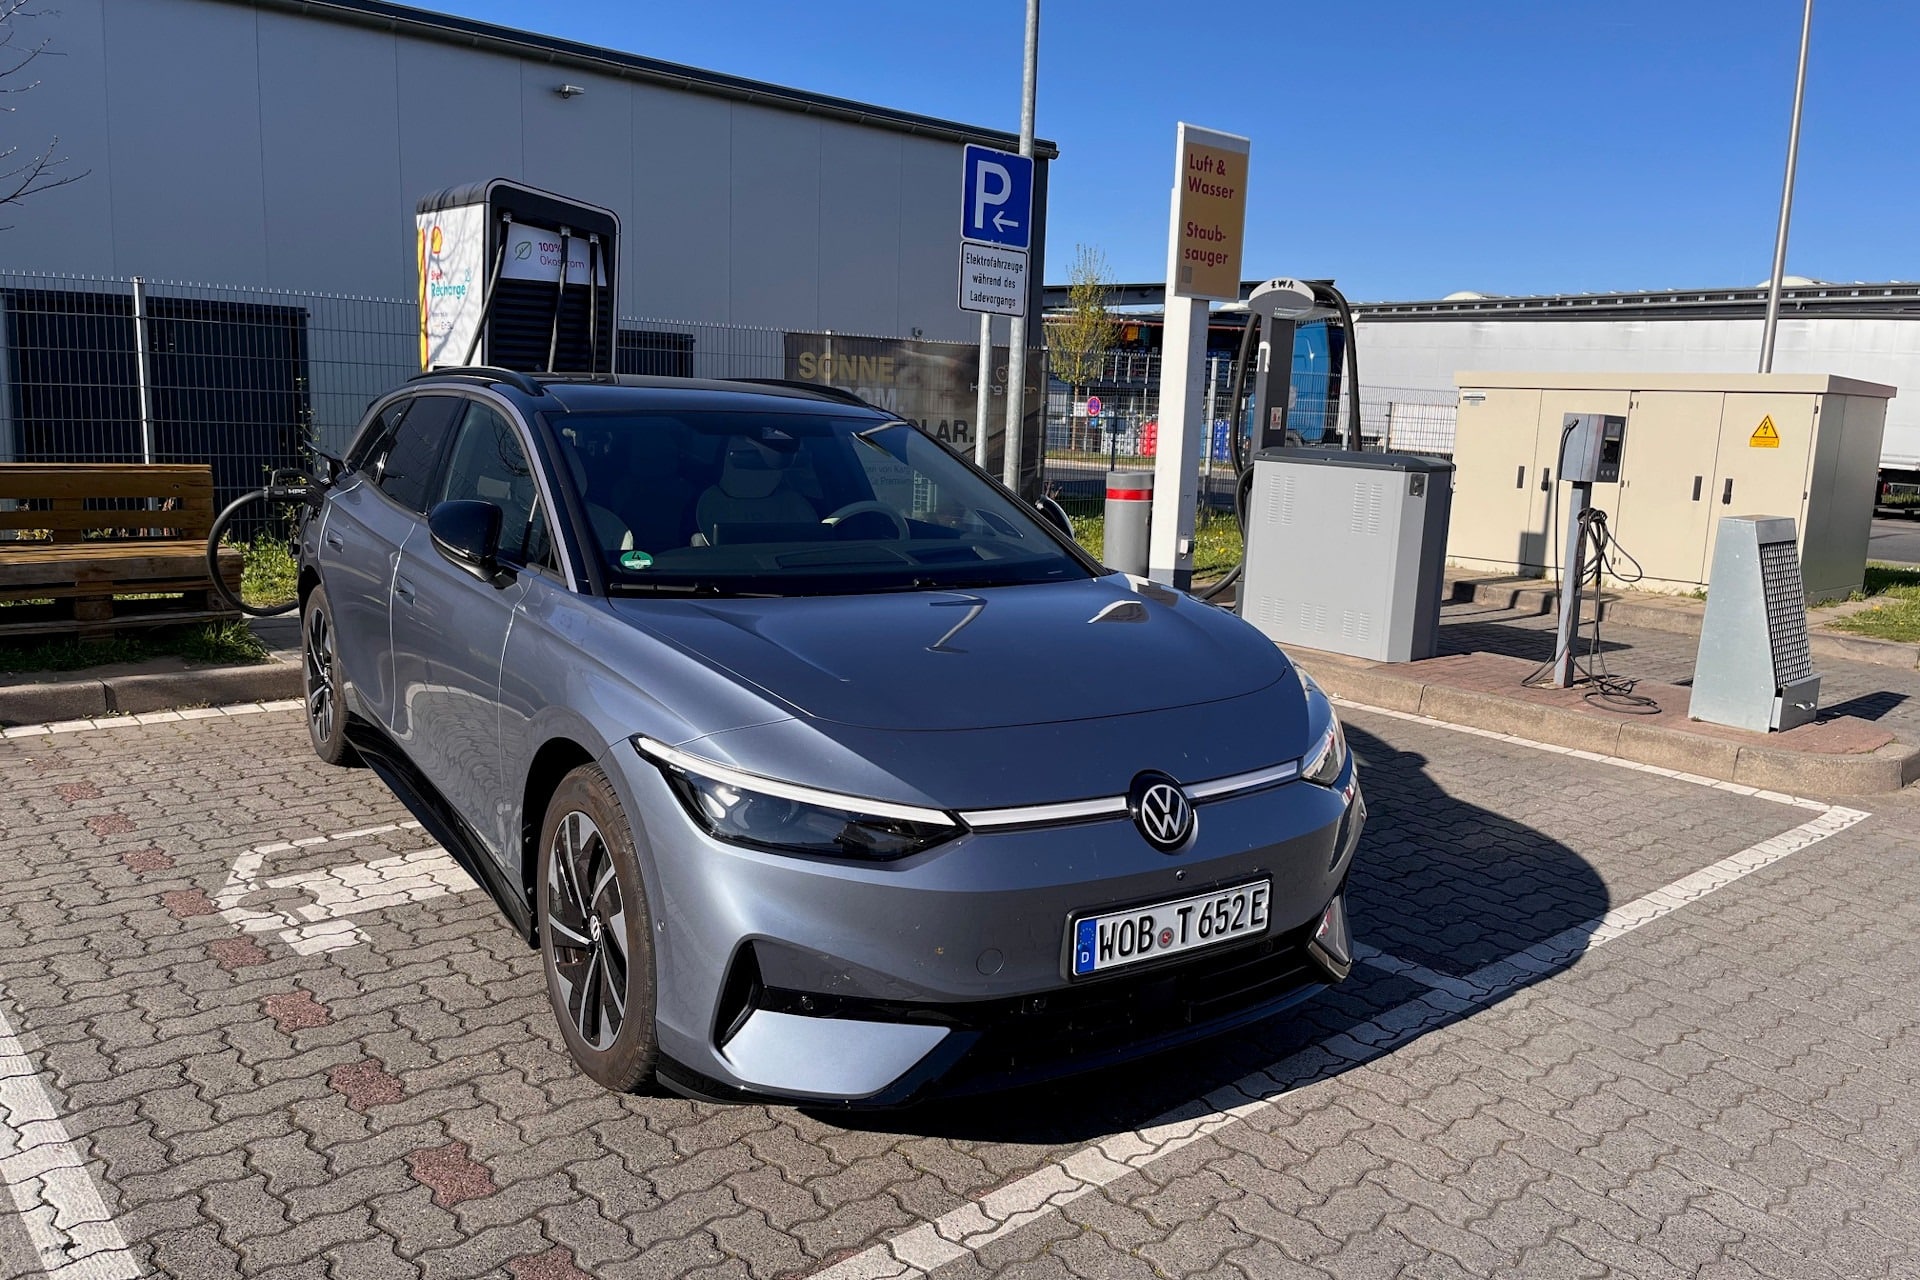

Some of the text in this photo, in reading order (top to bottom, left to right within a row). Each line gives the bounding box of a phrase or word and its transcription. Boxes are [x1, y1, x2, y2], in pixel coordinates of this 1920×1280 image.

[1189, 153, 1226, 176] Luft &
[974, 160, 1012, 229] P
[1188, 175, 1234, 199] Wasser
[1186, 221, 1226, 242] Staub-
[966, 252, 1024, 273] Elektrofahrzeuge
[1185, 247, 1228, 267] sauger
[431, 282, 466, 300] Recharge
[972, 273, 1016, 289] während des
[1271, 279, 1295, 289] EWA
[970, 290, 1016, 309] Ladevorgangs
[1081, 889, 1265, 963] D WOB T 652E
